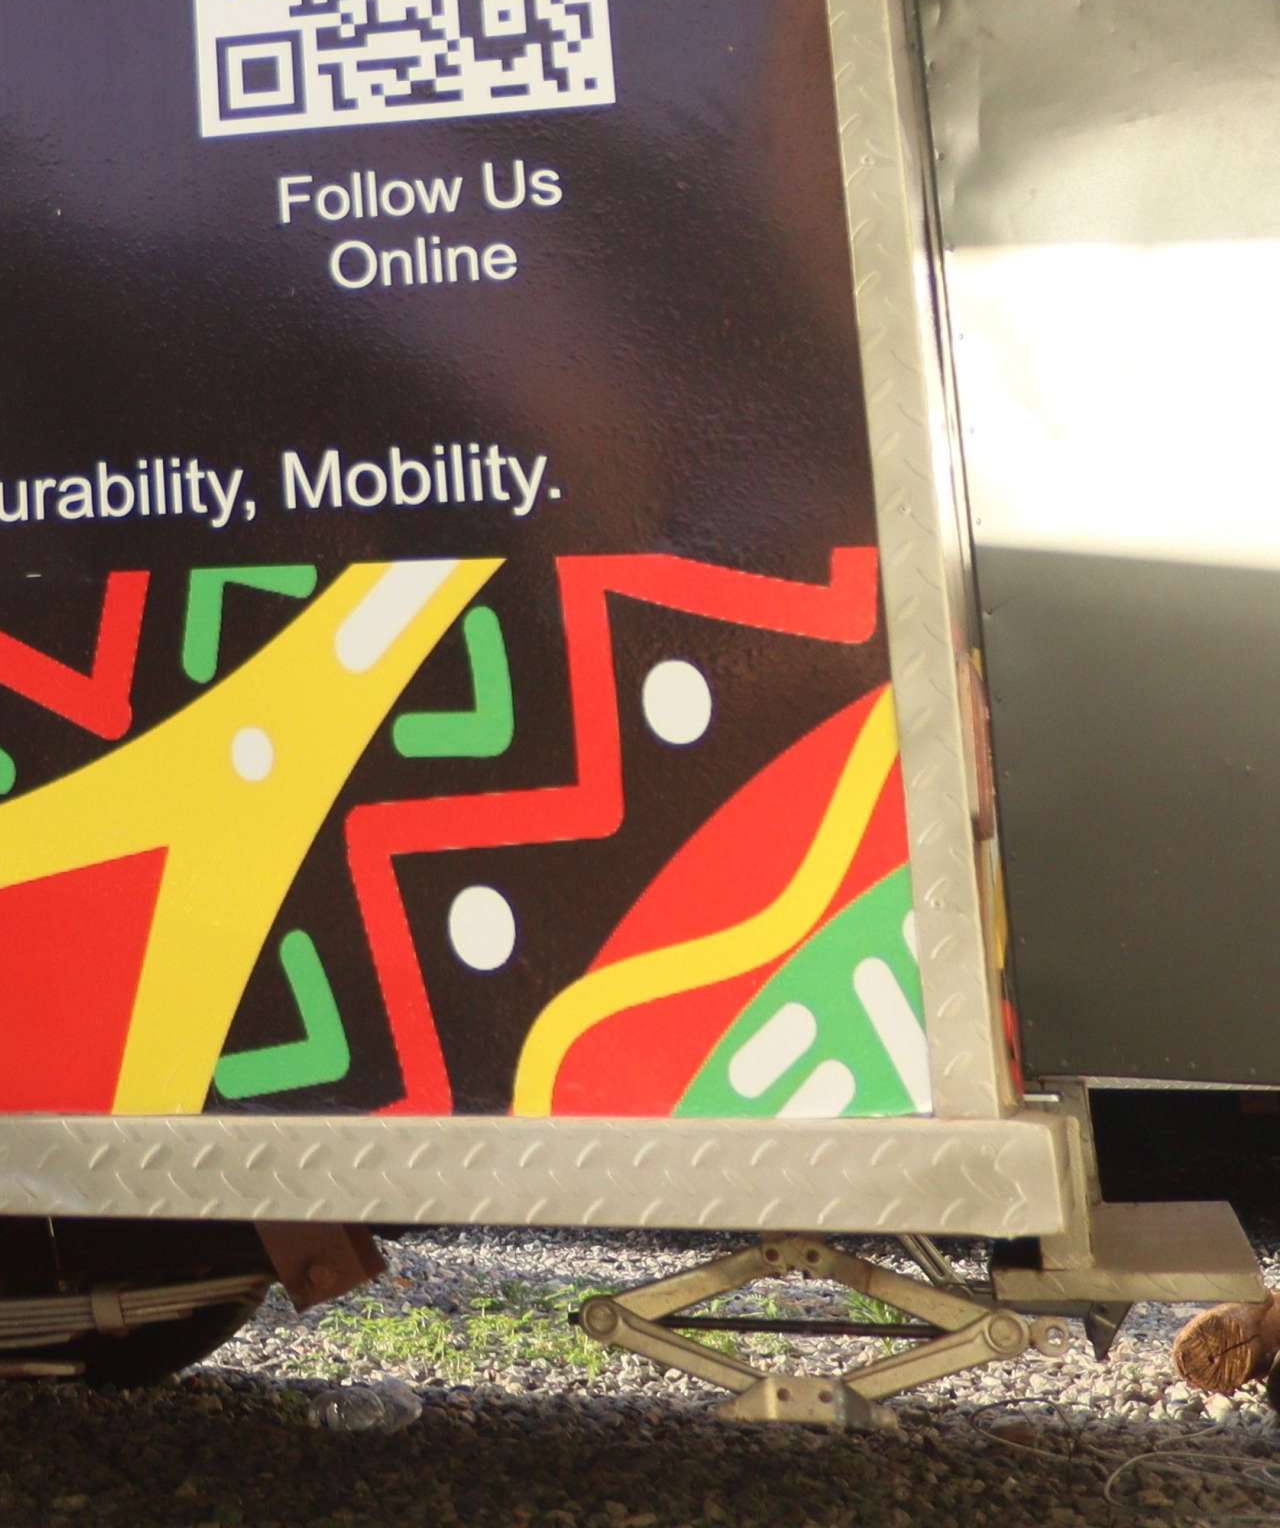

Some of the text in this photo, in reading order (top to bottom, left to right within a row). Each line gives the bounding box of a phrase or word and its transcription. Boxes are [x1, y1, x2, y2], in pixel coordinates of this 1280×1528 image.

[278, 159, 563, 224] Follow Us
[330, 235, 519, 290] Online
[282, 442, 562, 517] Mobility.
